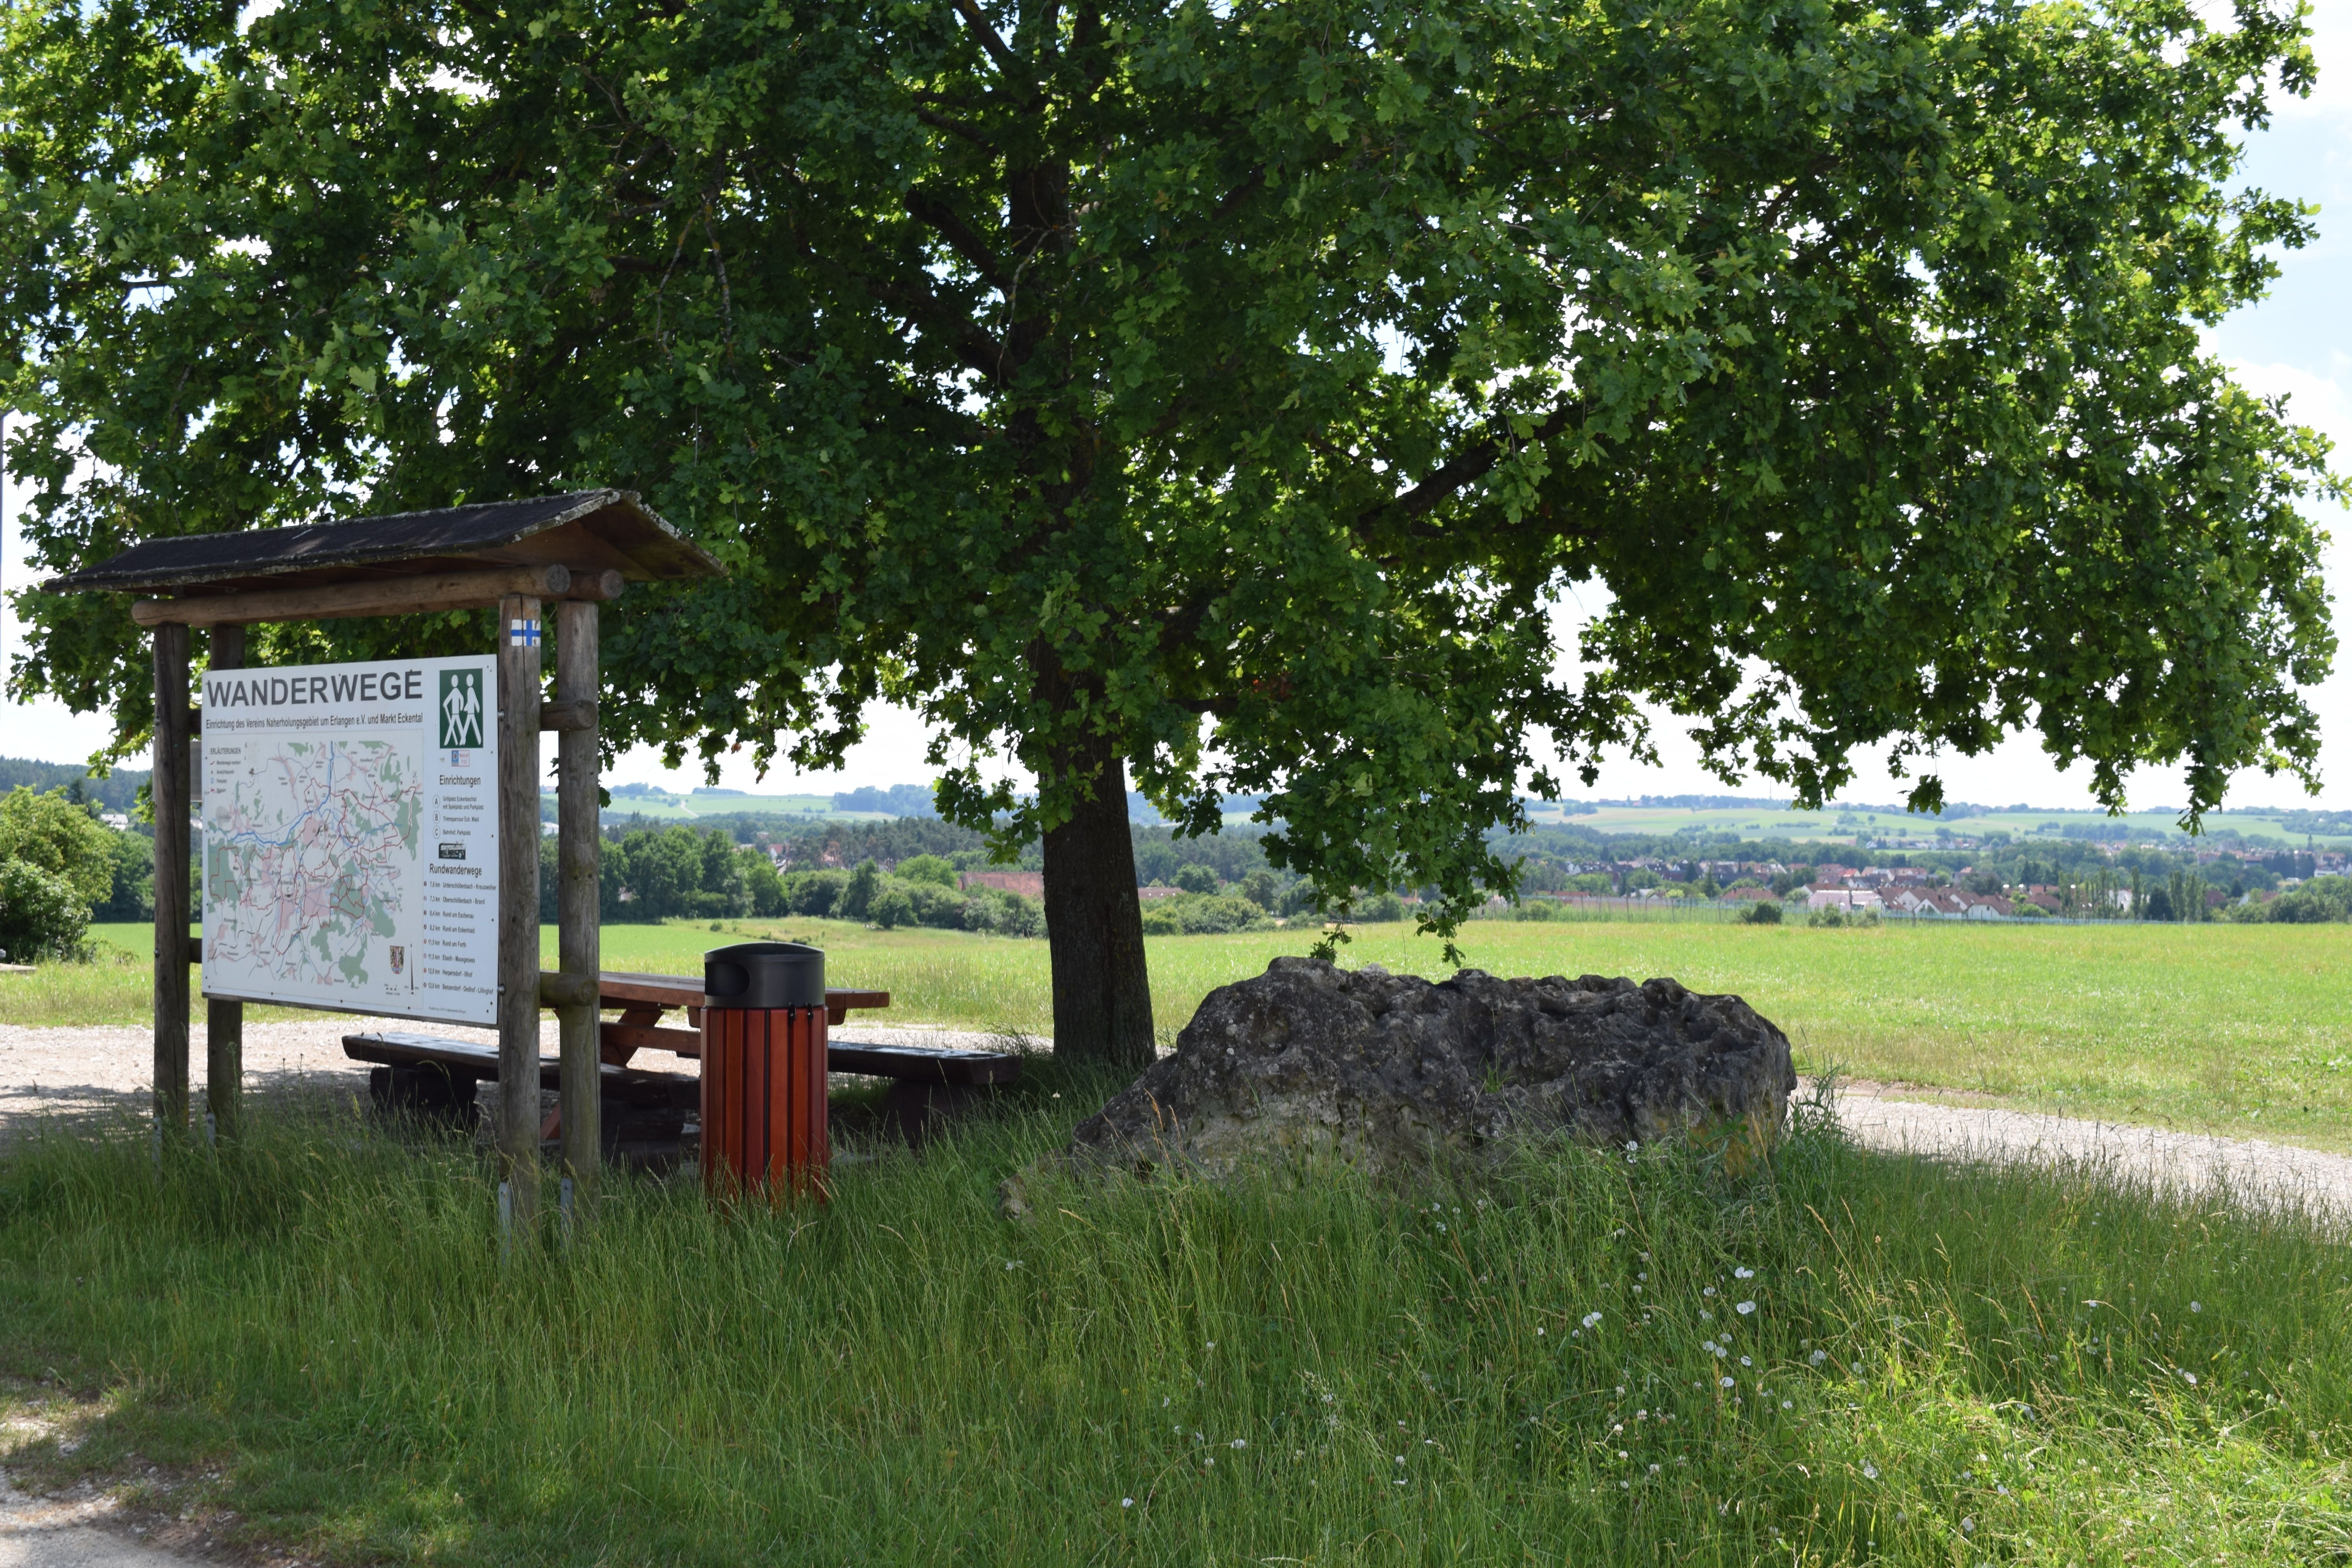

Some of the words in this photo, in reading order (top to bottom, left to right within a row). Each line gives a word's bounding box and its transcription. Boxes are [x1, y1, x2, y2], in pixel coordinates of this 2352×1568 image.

[207, 671, 423, 707] WANDERWEGE
[207, 718, 234, 730] Einrichtung
[236, 719, 245, 728] des
[247, 718, 265, 728] Vereins
[267, 716, 319, 729] Naherholungsgebiet
[331, 715, 354, 727] Erlangen
[357, 714, 366, 724] e.V.
[368, 714, 378, 724] und
[381, 713, 396, 723] Markt
[398, 712, 423, 723] Eckental
[211, 746, 241, 755] ERLÄUTERUNGEN
[440, 775, 481, 788] Einrichtungen
[430, 863, 482, 878] Rundwanderwege
